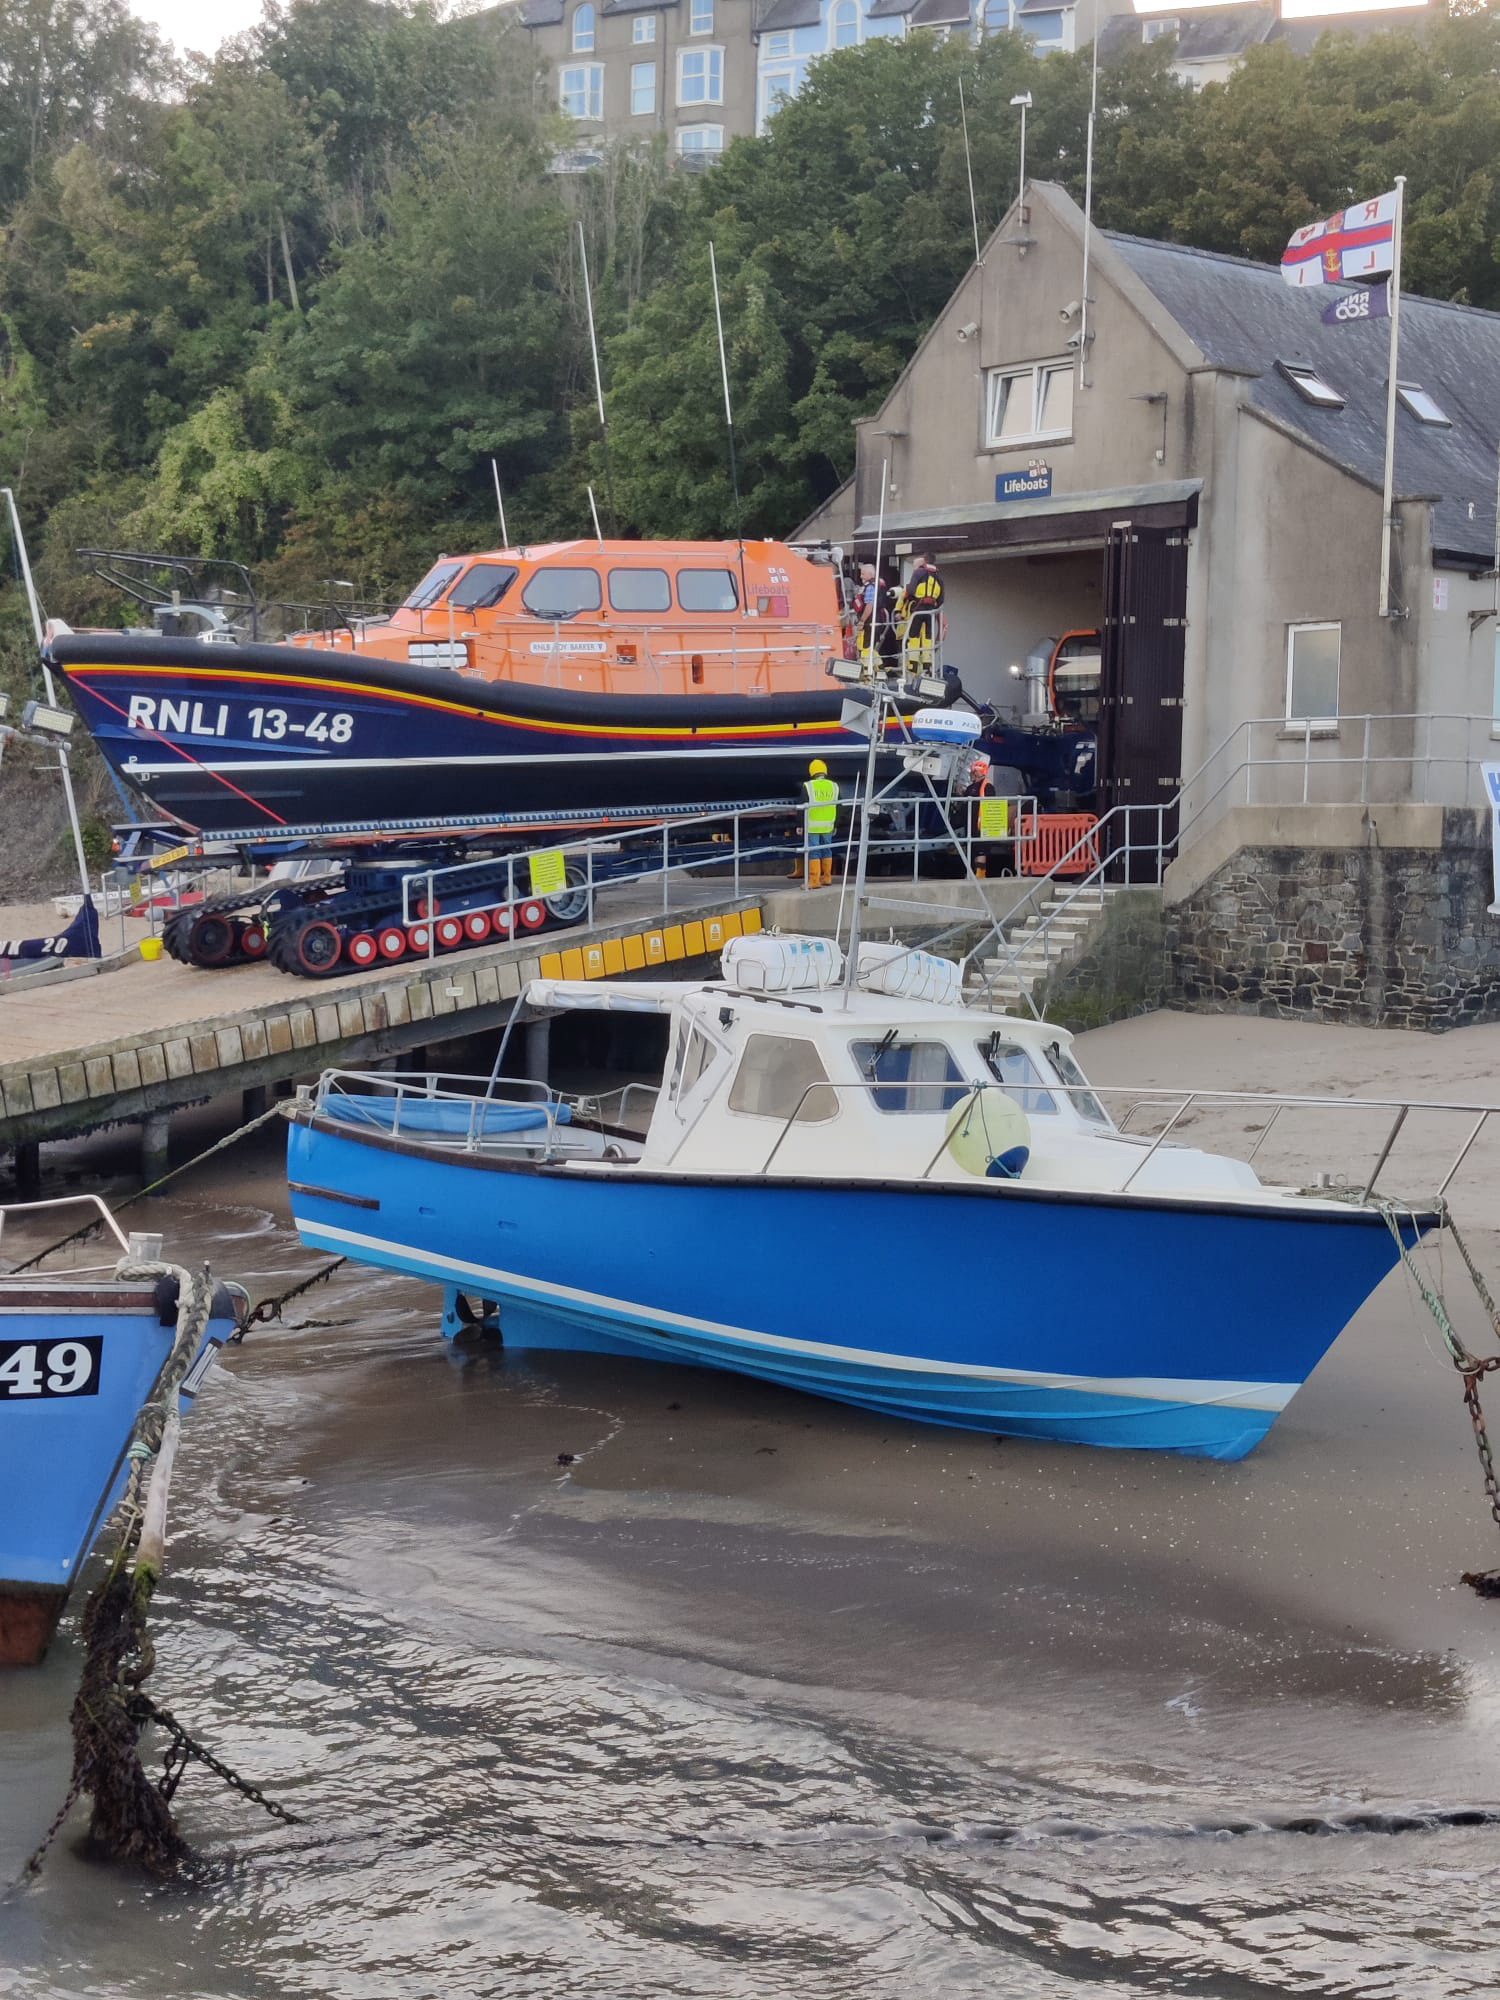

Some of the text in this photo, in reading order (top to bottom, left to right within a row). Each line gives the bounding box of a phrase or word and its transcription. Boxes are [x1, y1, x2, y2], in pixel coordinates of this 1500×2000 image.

[1004, 478, 1048, 494] Lifeboats
[127, 695, 355, 744] RNLI 13-48
[41, 937, 69, 954] 20
[0, 1341, 92, 1395] 49
